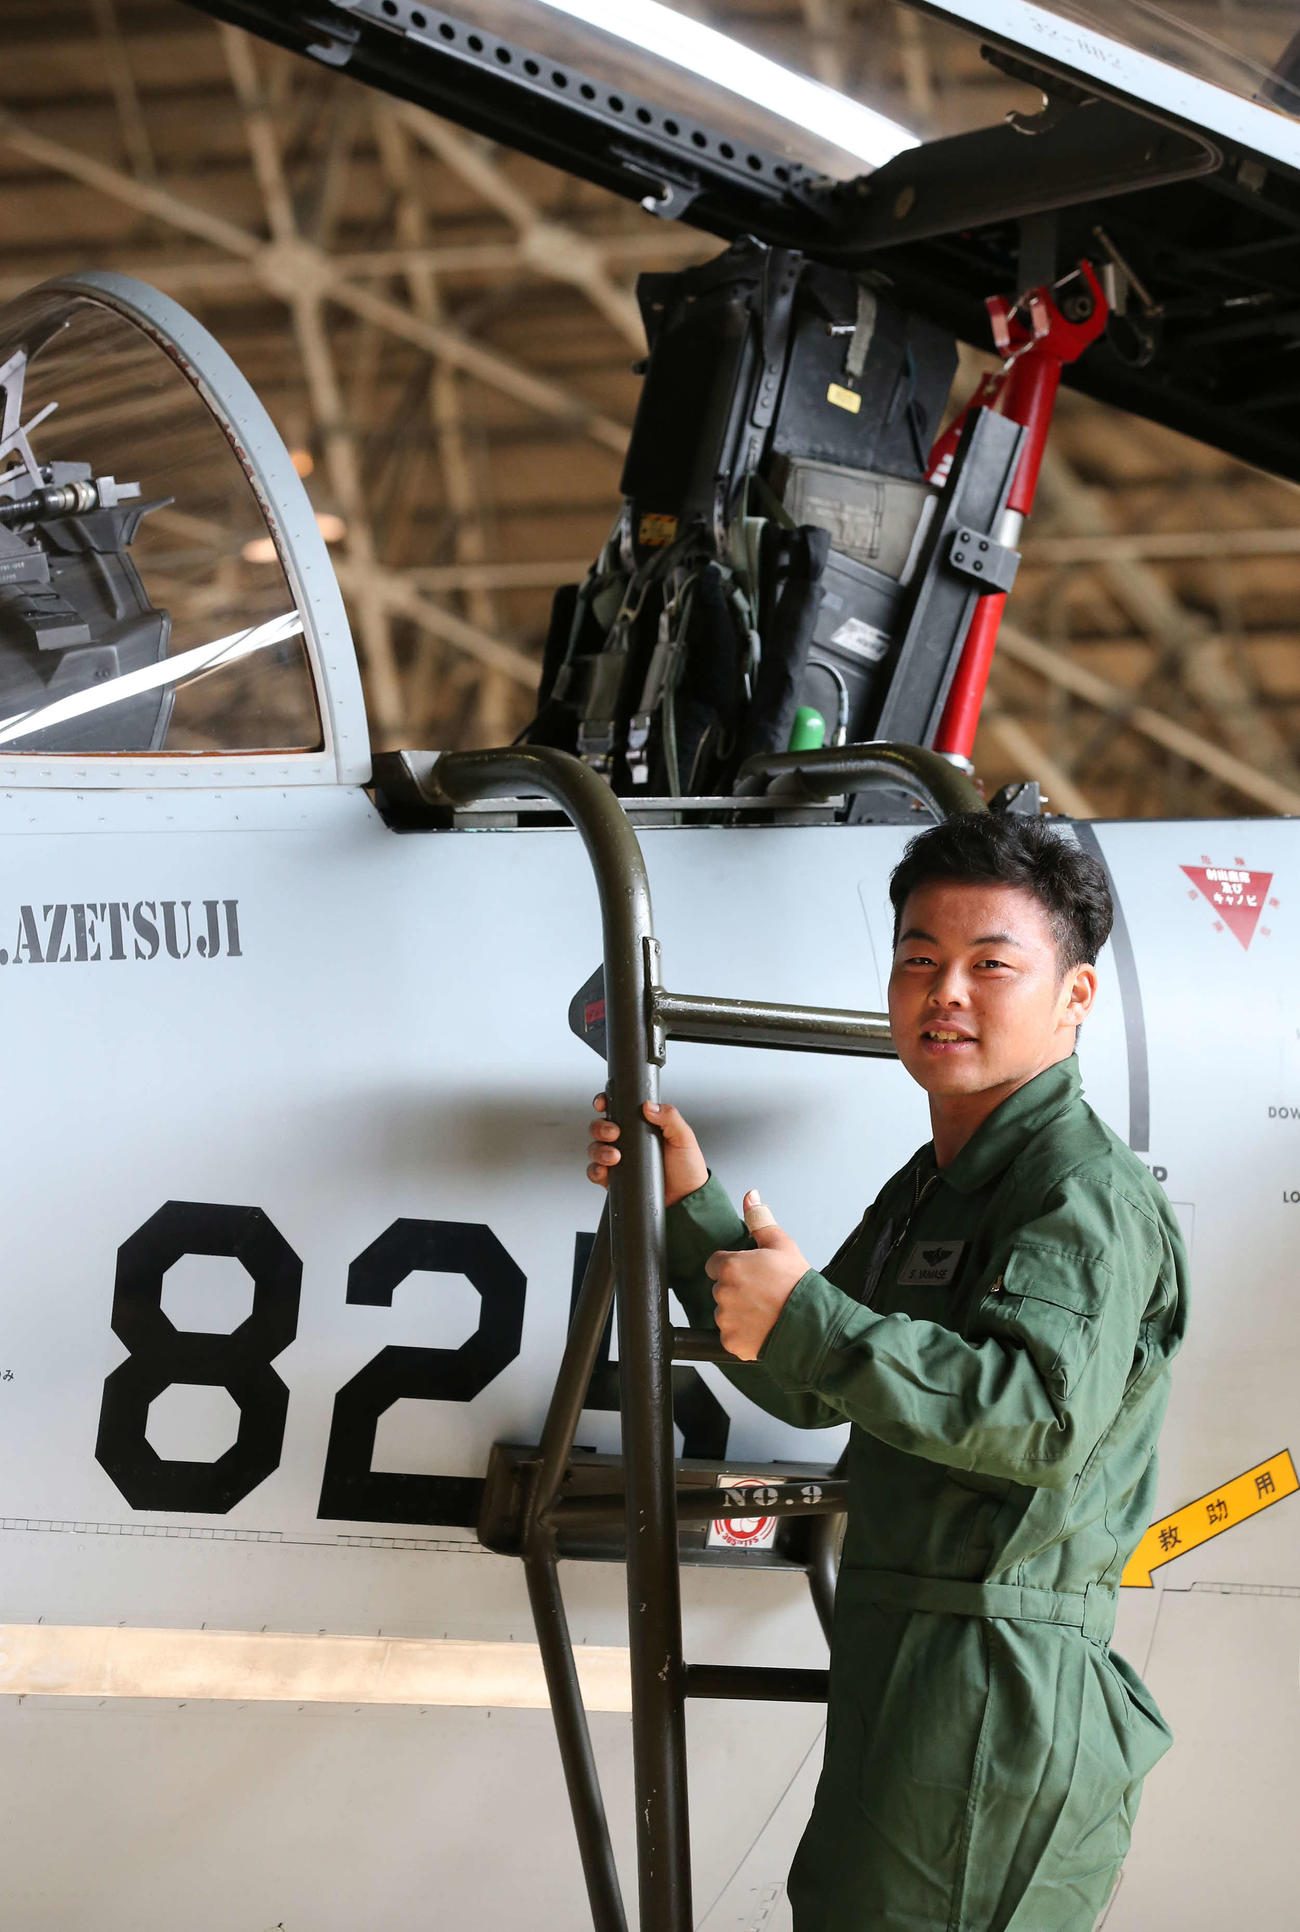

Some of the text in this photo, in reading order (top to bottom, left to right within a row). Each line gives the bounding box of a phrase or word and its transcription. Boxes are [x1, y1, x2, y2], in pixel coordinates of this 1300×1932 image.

[0, 1369, 14, 1382] み
[96, 1199, 731, 1528] 82
[722, 1485, 823, 1507] NO.9
[1158, 1471, 1275, 1552] 救助用
